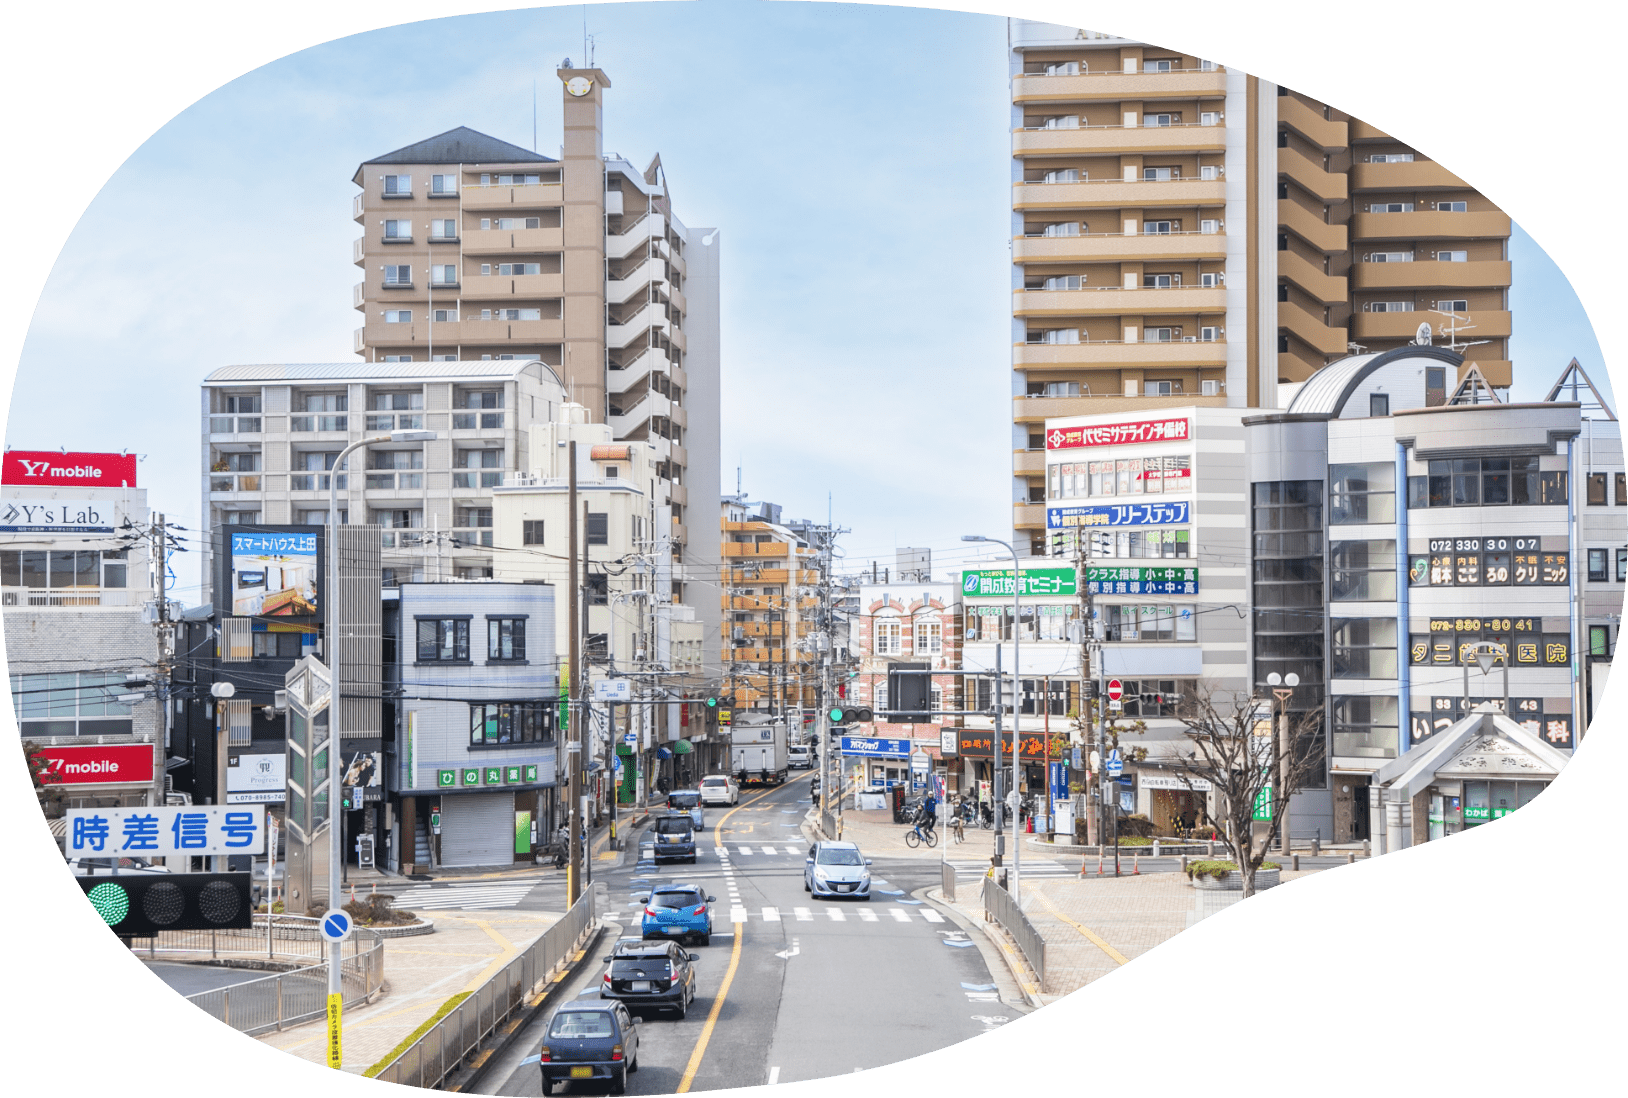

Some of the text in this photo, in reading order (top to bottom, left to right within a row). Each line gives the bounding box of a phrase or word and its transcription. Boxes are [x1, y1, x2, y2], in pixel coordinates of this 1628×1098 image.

[1082, 420, 1186, 445] 代ゼミサテライン予備校
[17, 459, 103, 479] Y!mobile
[21, 505, 105, 524] Y's Lab.
[1111, 502, 1187, 525] フリーステップ
[234, 537, 317, 552] スマートハウス上田
[1430, 539, 1537, 551] 072 330 30 07
[1544, 556, 1566, 565] 不安
[1088, 568, 1195, 581] クラス指導 小・中・高
[980, 576, 1075, 595] 開成教育セミナー
[1088, 581, 1195, 593] 個別指導 小・中・高
[599, 683, 625, 691] 上田
[1465, 809, 1489, 817] わかば
[72, 812, 258, 851] 時差信号
